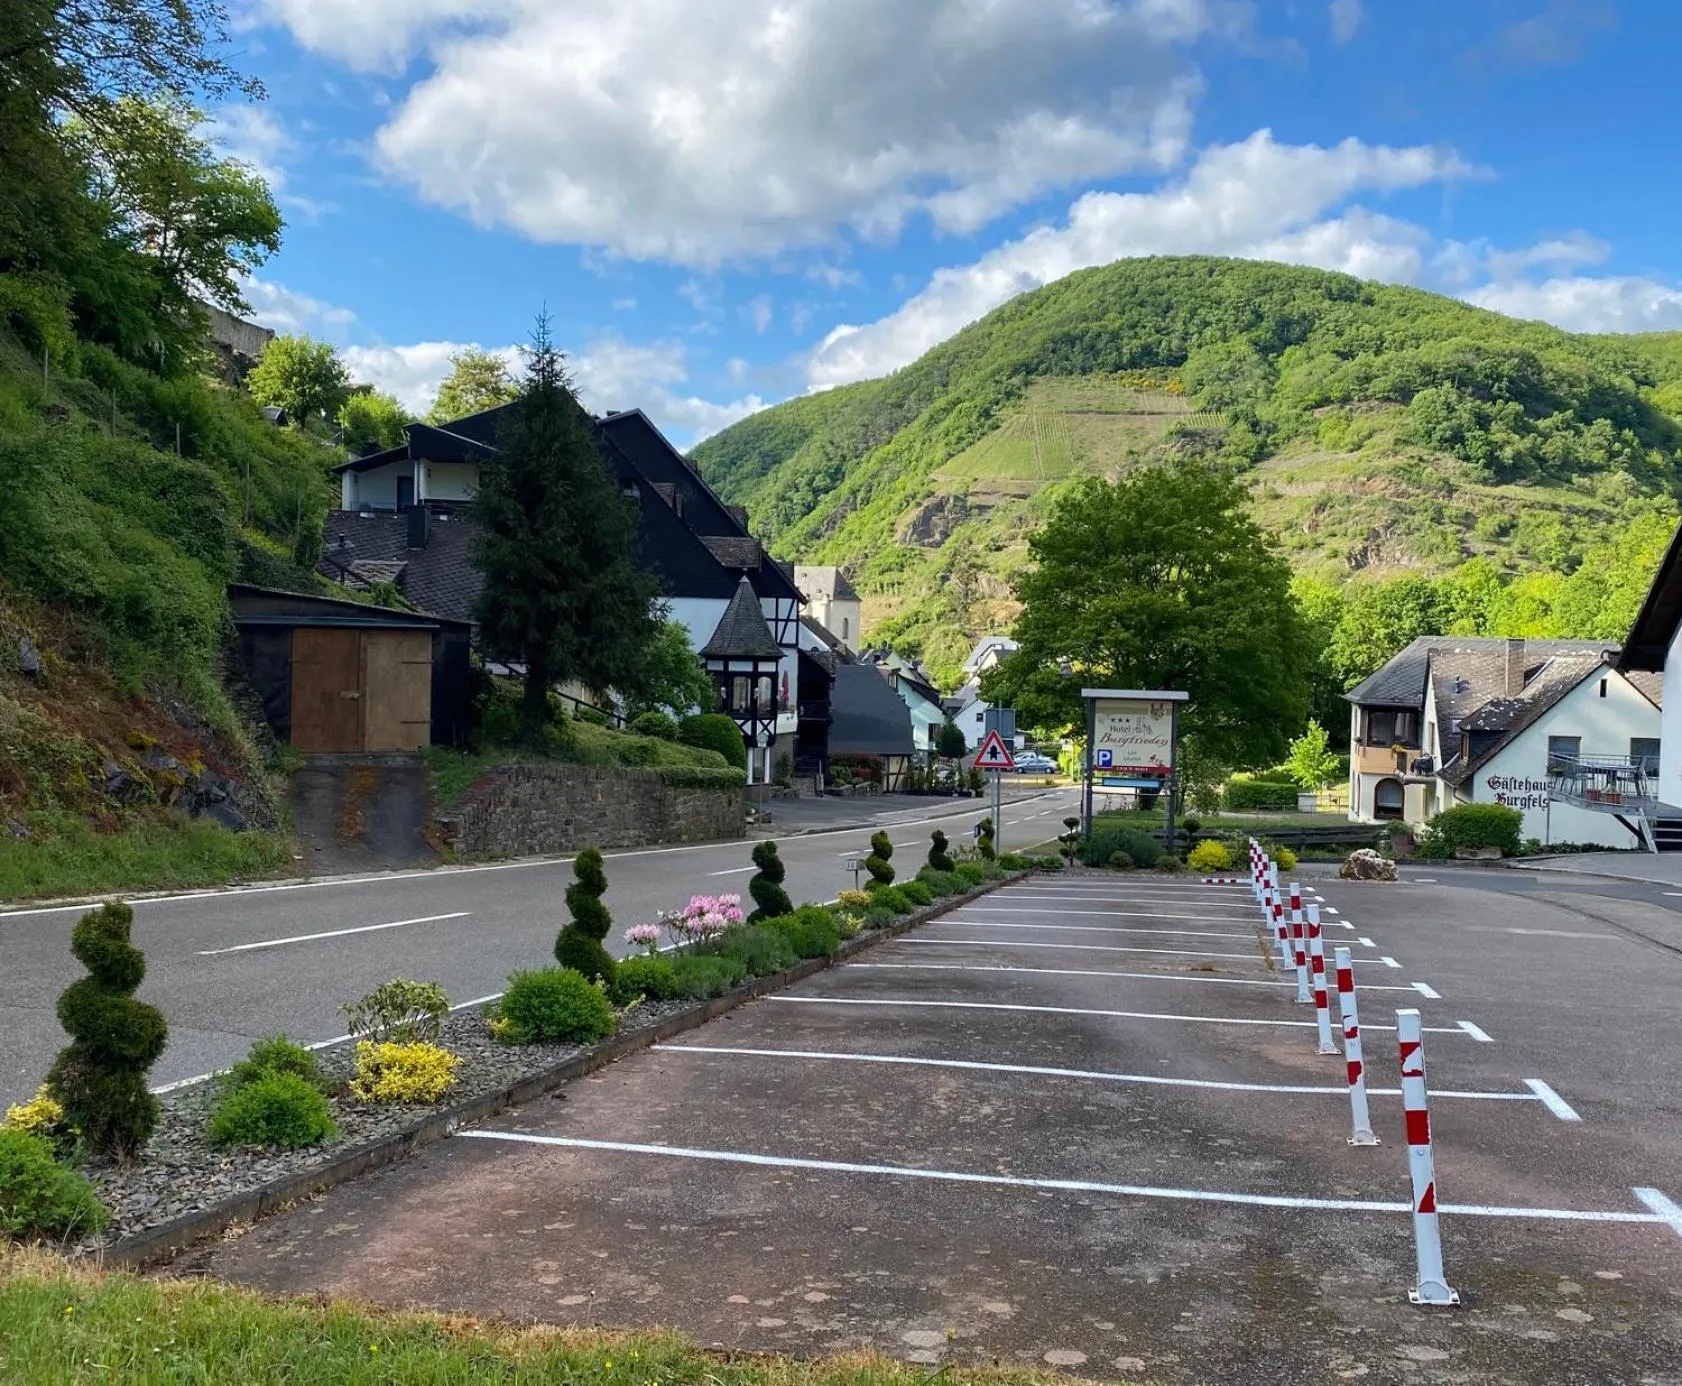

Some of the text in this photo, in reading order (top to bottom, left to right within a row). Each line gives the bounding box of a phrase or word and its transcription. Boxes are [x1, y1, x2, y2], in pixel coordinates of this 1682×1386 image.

[1109, 725, 1131, 733] Hotel
[1099, 751, 1111, 766] P
[1494, 792, 1550, 811] Burgfels
